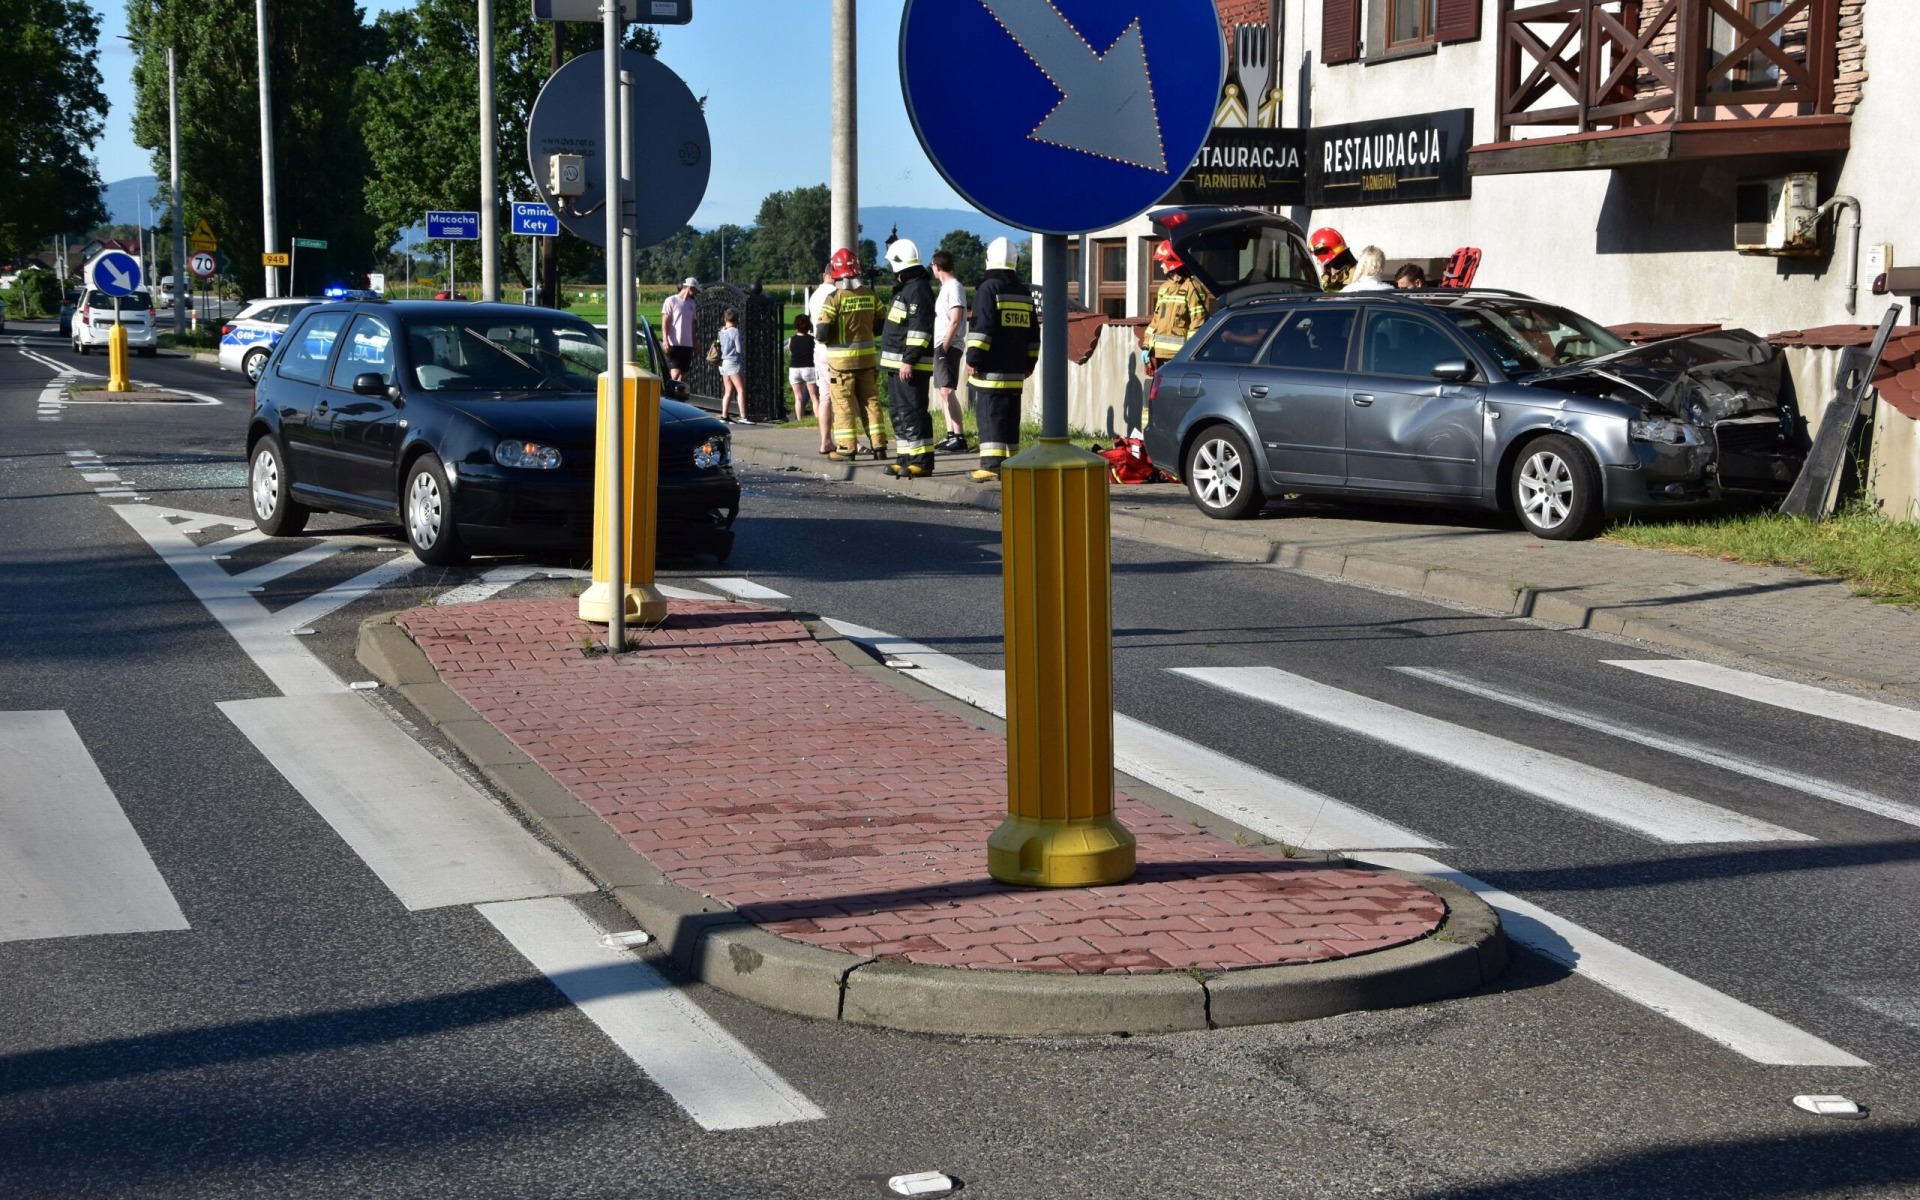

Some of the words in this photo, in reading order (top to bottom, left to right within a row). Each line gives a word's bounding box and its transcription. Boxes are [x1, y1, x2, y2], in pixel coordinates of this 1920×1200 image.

[1324, 128, 1440, 173] RESTAURACJA
[1192, 147, 1299, 168] TAURACJA
[430, 214, 475, 224] Macocha
[523, 219, 547, 232] Kęty
[195, 257, 213, 271] 70
[267, 255, 285, 264] 948
